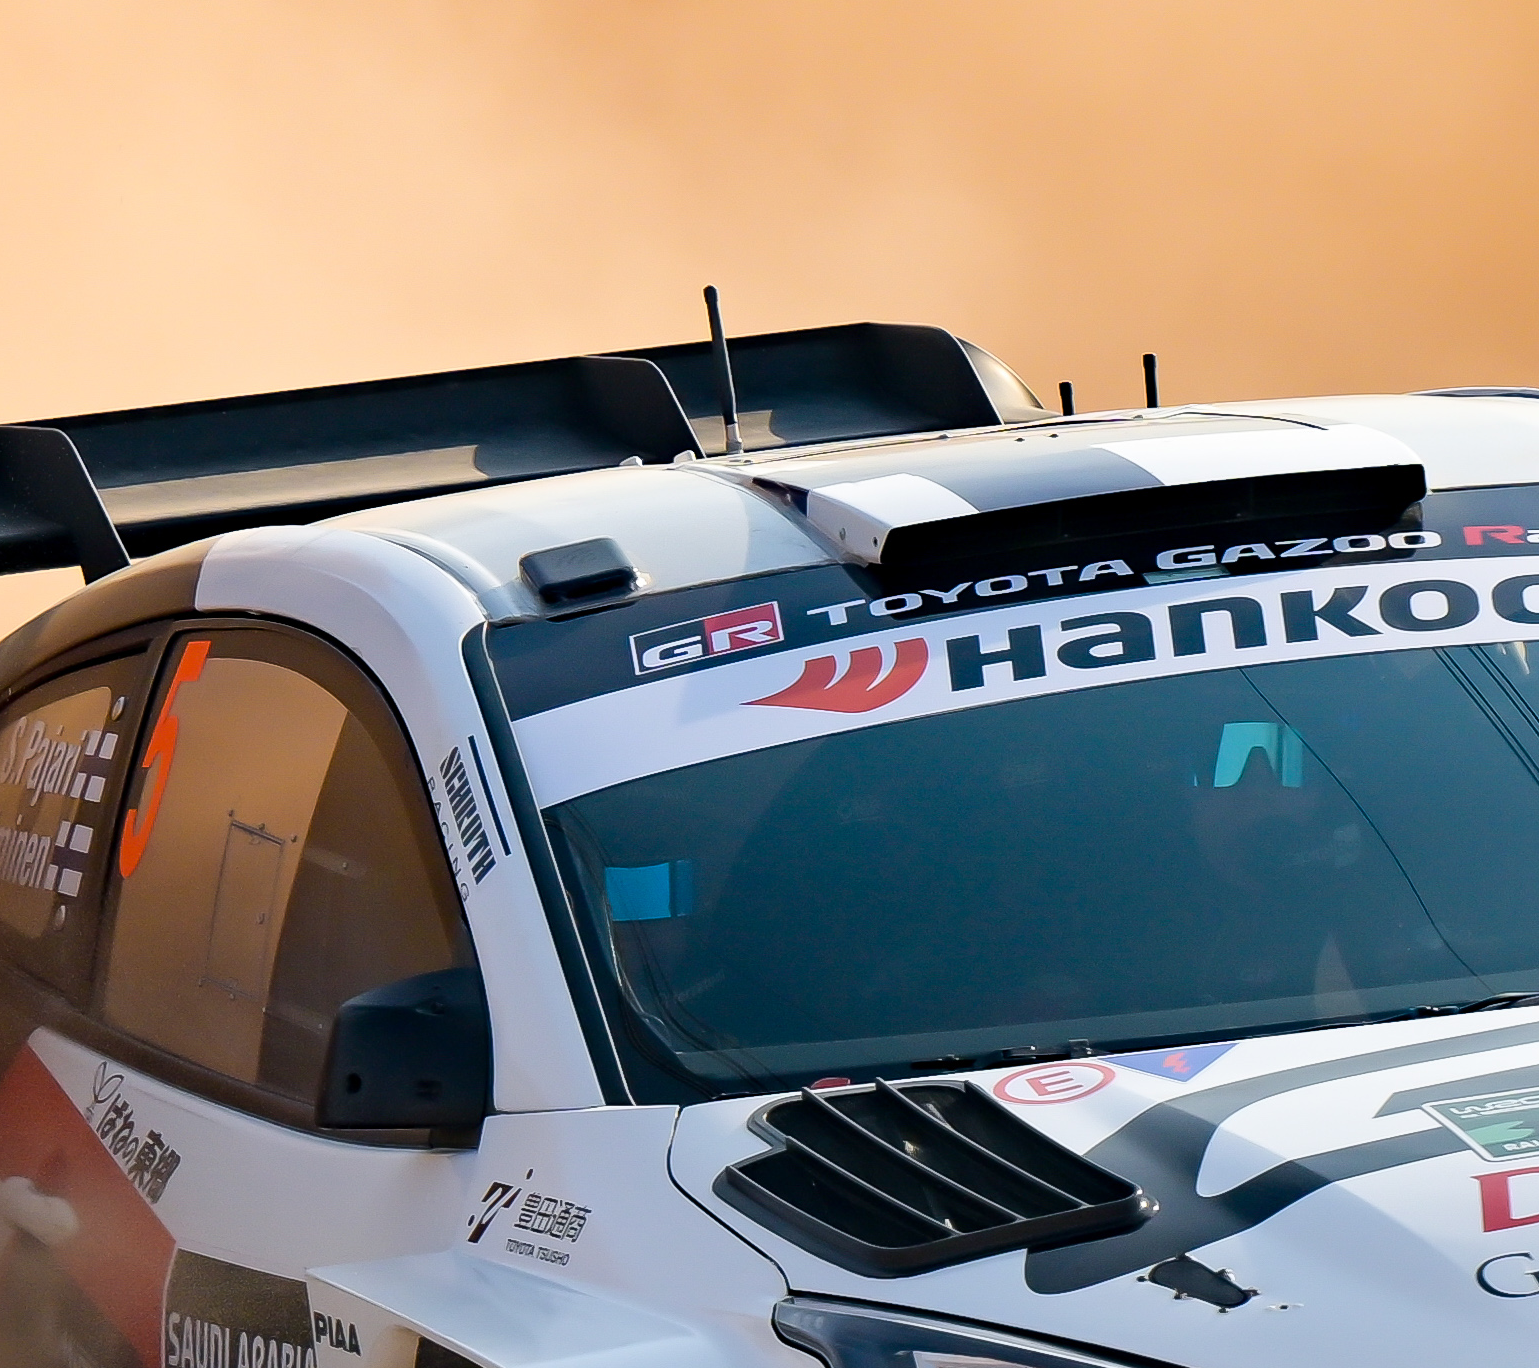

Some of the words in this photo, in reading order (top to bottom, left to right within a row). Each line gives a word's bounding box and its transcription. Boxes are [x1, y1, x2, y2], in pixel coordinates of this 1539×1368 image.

[806, 558, 1134, 626] TOYOTA
[1156, 530, 1443, 571] GAZOO
[641, 618, 776, 669] GR
[119, 640, 211, 878] 5
[1025, 1070, 1084, 1097] E
[314, 1310, 362, 1357] PIAA
